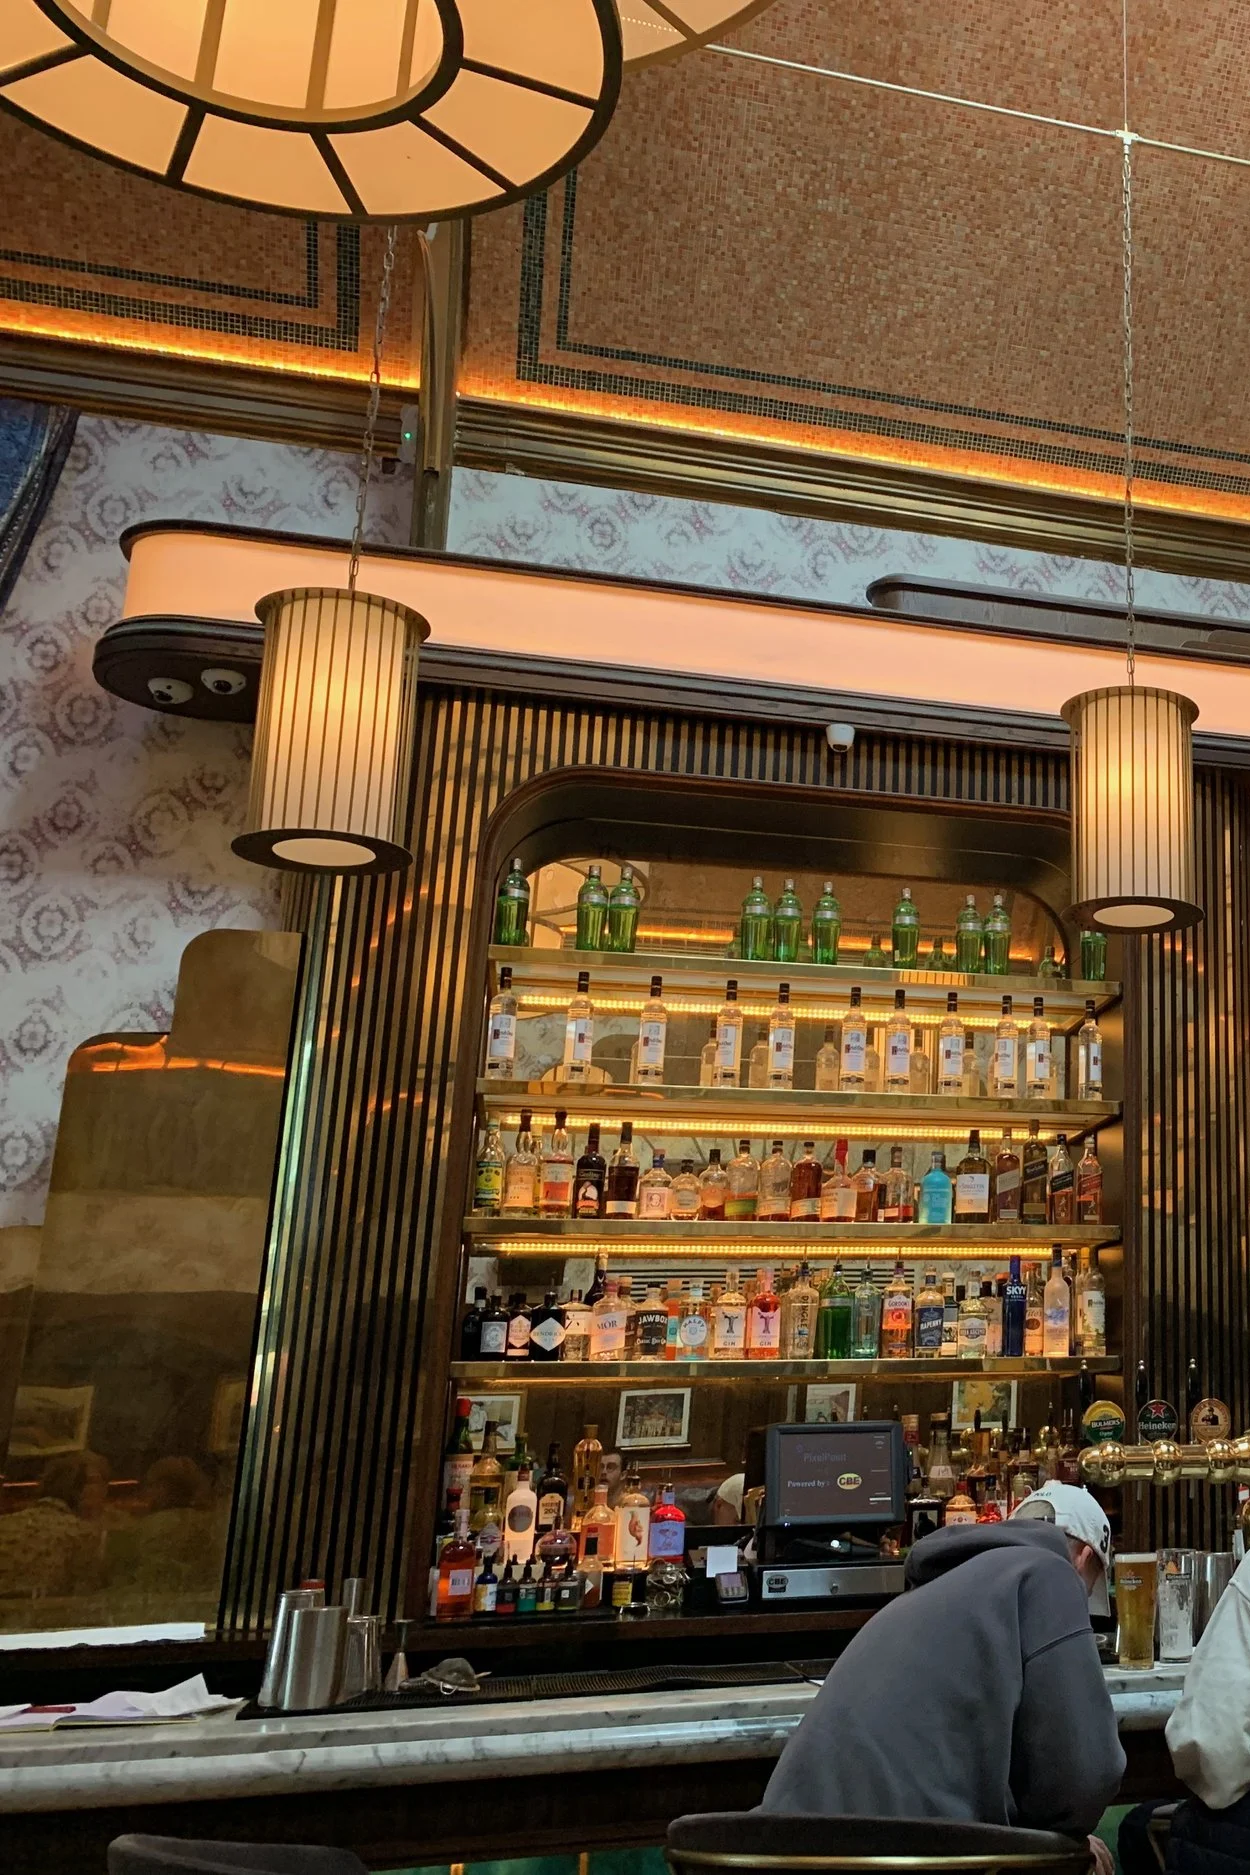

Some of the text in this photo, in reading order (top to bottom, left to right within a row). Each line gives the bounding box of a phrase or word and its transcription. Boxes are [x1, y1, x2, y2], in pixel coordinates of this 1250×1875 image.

[1006, 1286, 1026, 1295] SKYY
[800, 1295, 809, 1328] DINGLE
[1091, 1418, 1121, 1428] BULMERS
[1138, 1421, 1177, 1430] Heineken
[787, 1480, 815, 1488] Powered
[817, 1479, 825, 1488] by
[839, 1476, 860, 1486] CBE
[768, 1577, 788, 1586] CBE
